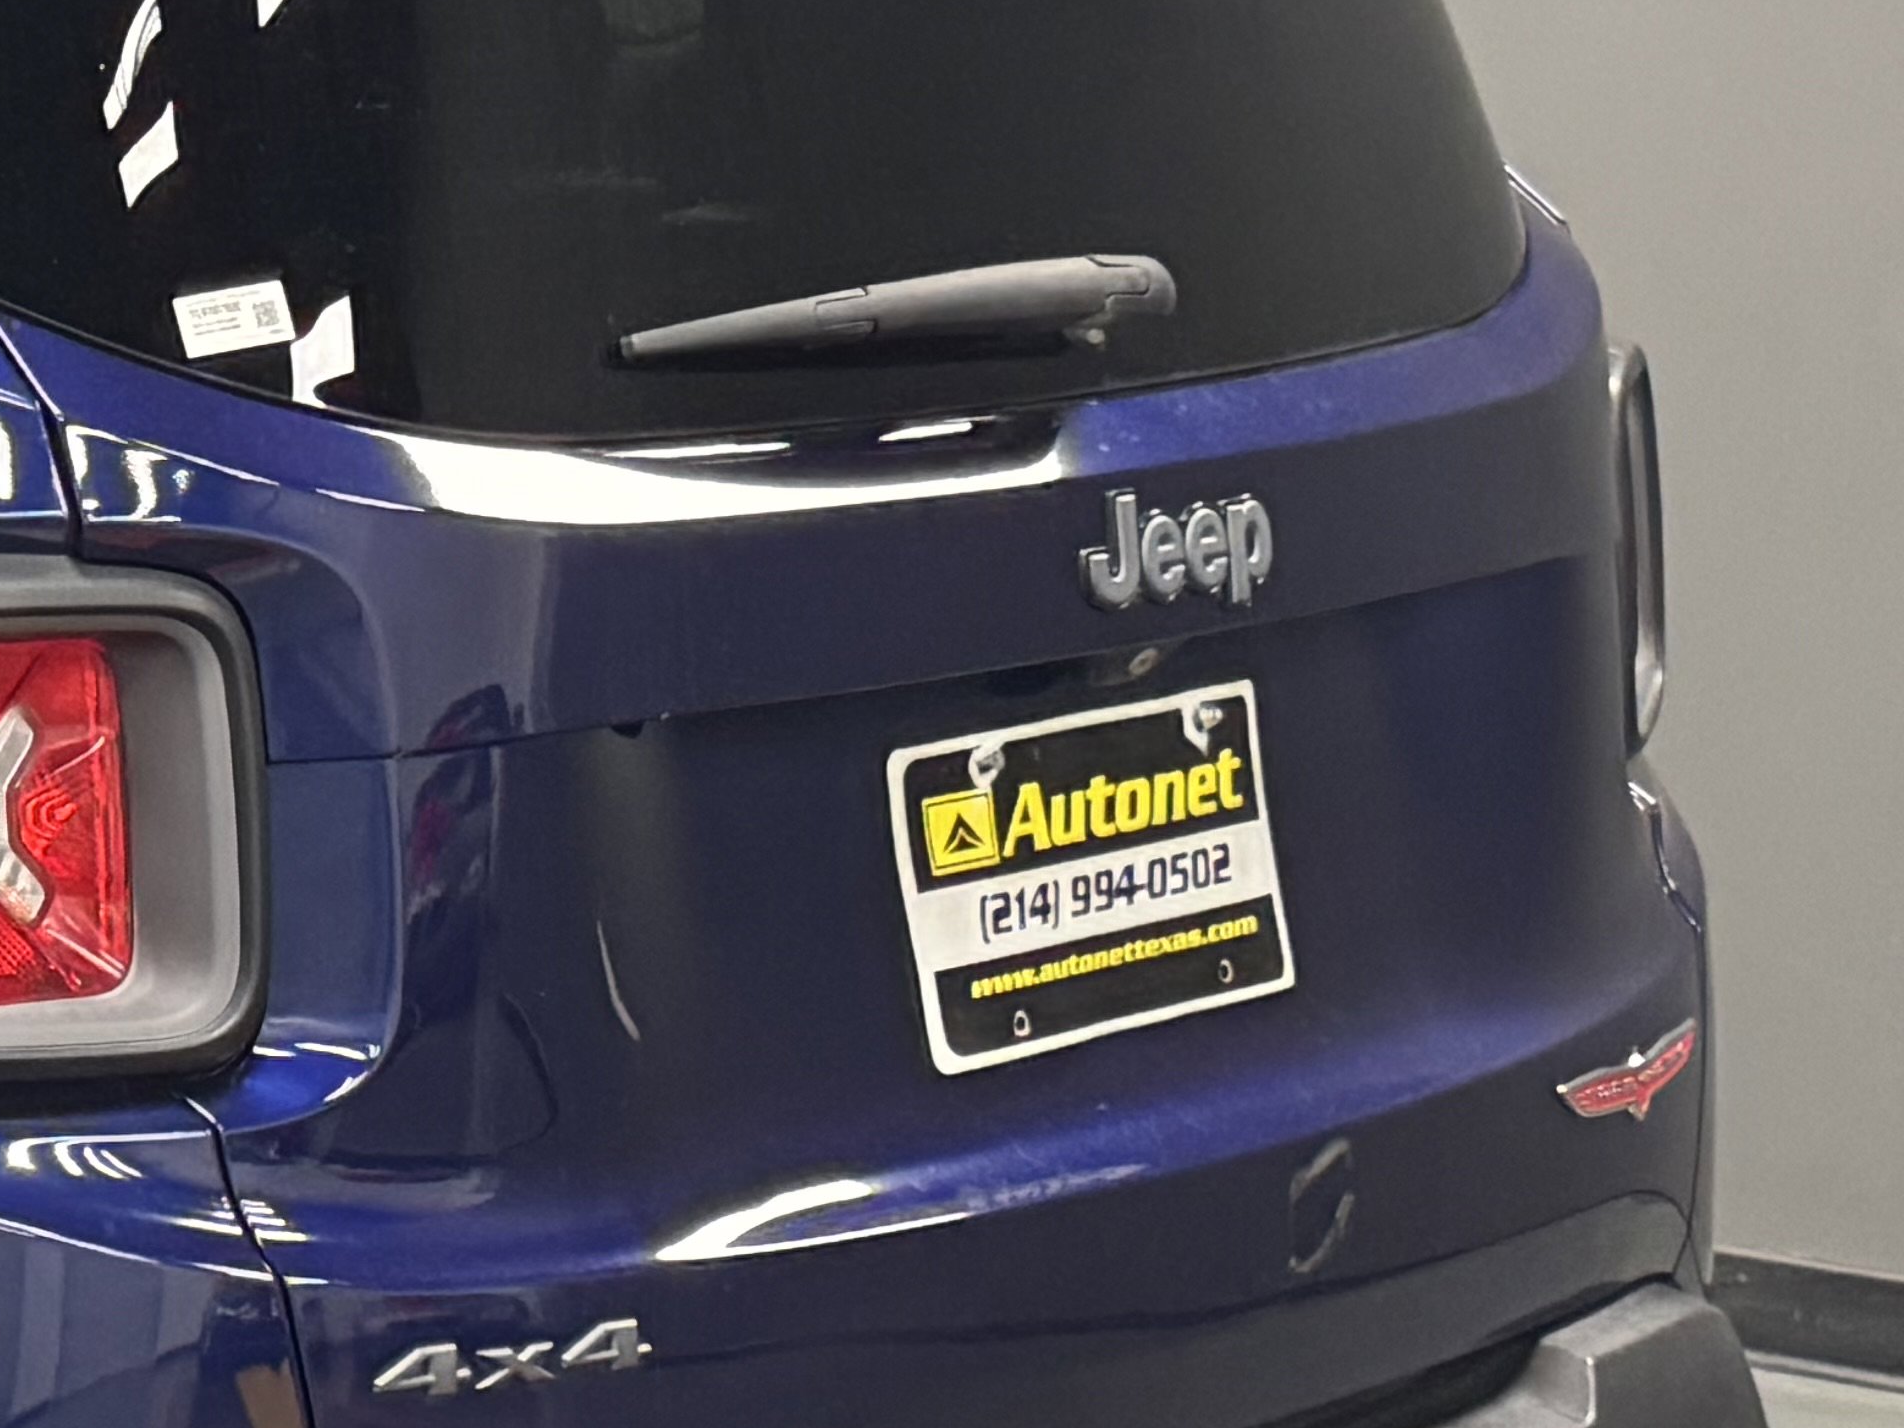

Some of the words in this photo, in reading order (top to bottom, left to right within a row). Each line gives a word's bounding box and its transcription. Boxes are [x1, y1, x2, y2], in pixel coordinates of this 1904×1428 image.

[1078, 487, 1273, 608] Jeep
[1002, 747, 1245, 857] Autonet
[979, 879, 1061, 944] (214)
[1070, 842, 1233, 917] 994-0502
[970, 914, 1259, 999] www.autonettexas.com
